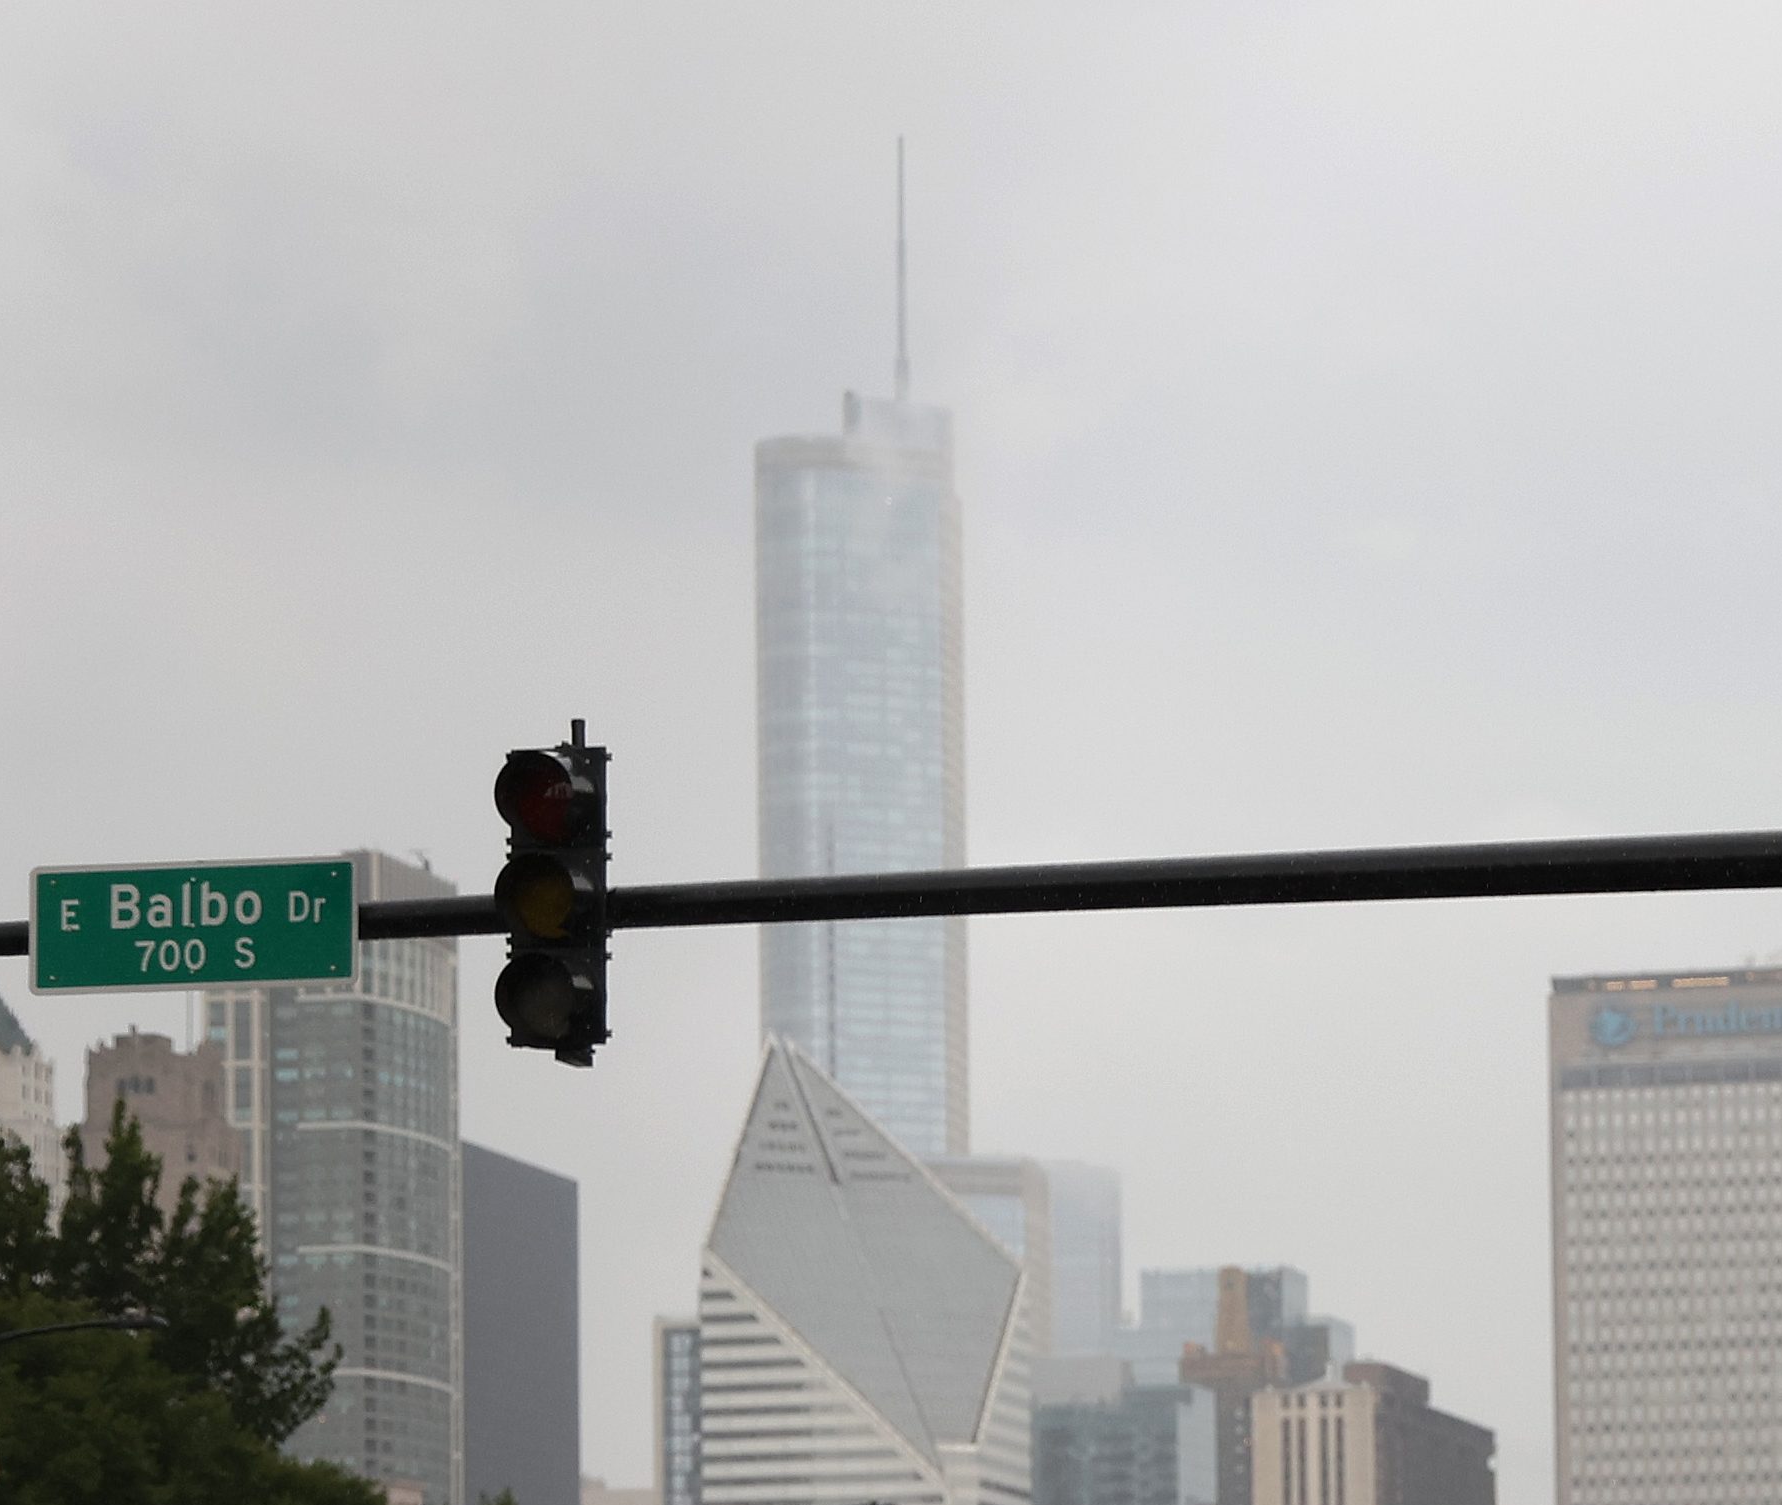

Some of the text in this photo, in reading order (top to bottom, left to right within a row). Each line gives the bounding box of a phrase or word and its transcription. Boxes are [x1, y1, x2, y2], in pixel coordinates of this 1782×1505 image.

[60, 881, 327, 931] E Balbo Dr
[134, 936, 256, 973] 700 S
